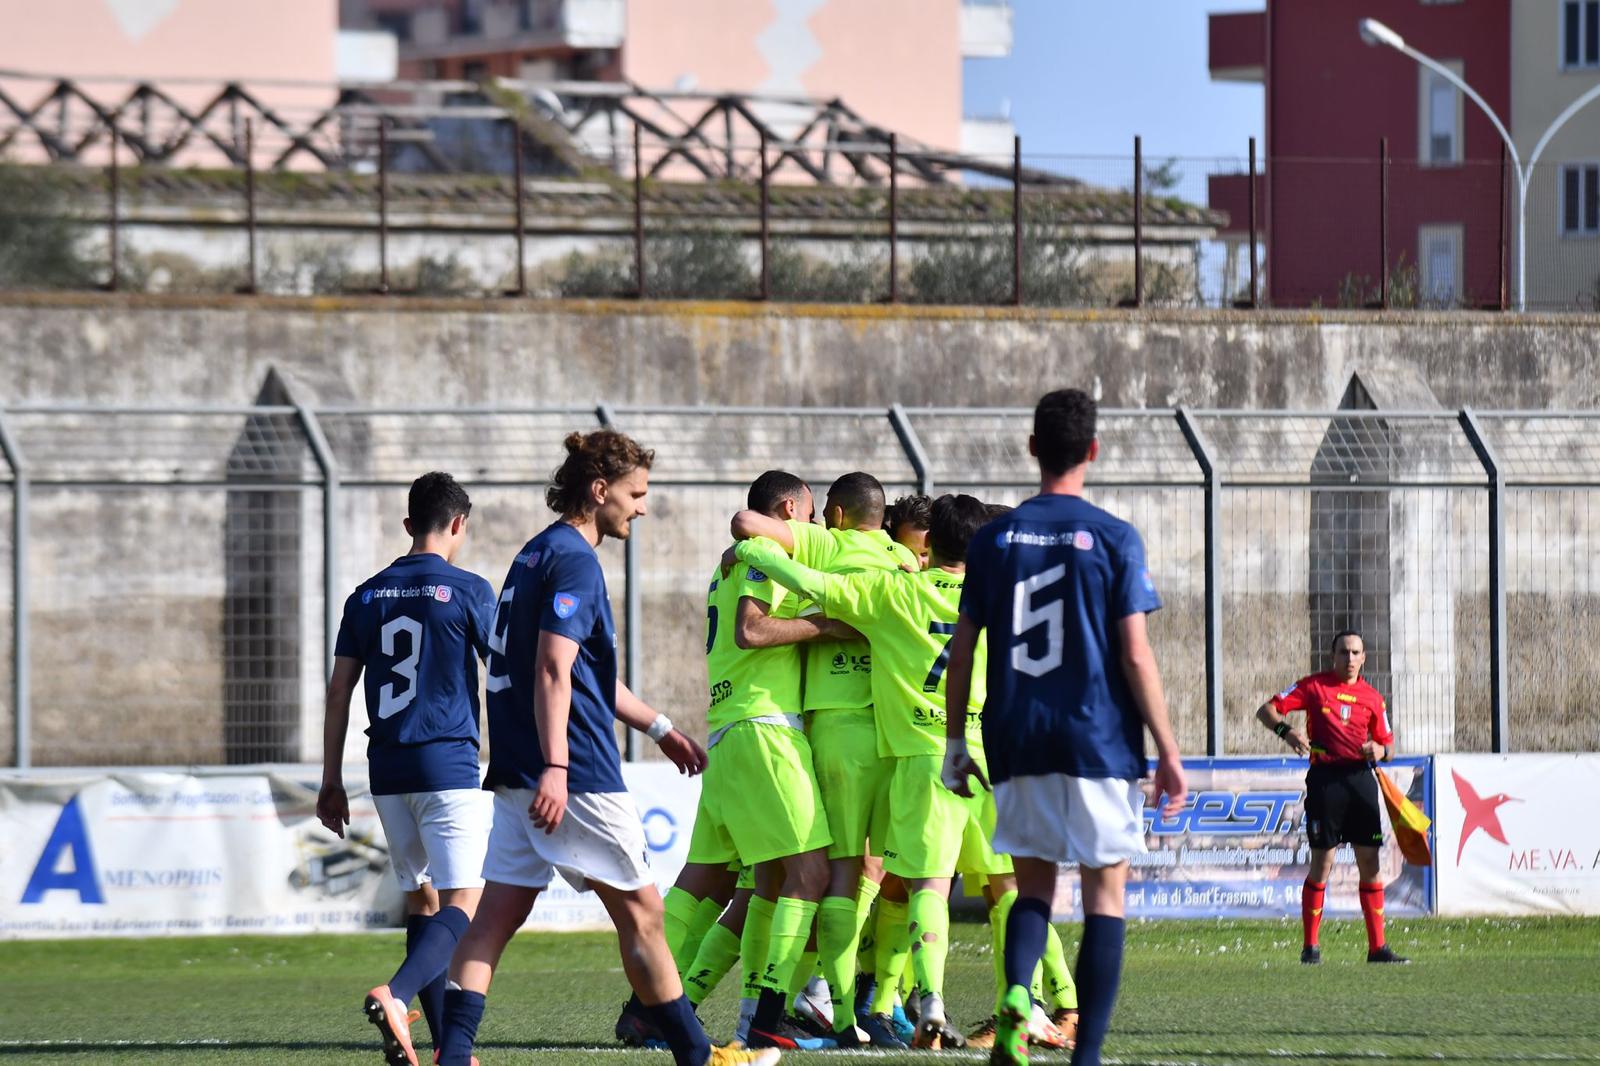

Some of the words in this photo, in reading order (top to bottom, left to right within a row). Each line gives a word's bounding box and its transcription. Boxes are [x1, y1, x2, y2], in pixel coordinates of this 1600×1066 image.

[1011, 562, 1066, 679] 5
[377, 615, 423, 719] 3
[922, 621, 959, 693] 7
[1508, 848, 1584, 871] ME.VA.
[1151, 890, 1169, 906] via
[1171, 888, 1181, 905] di
